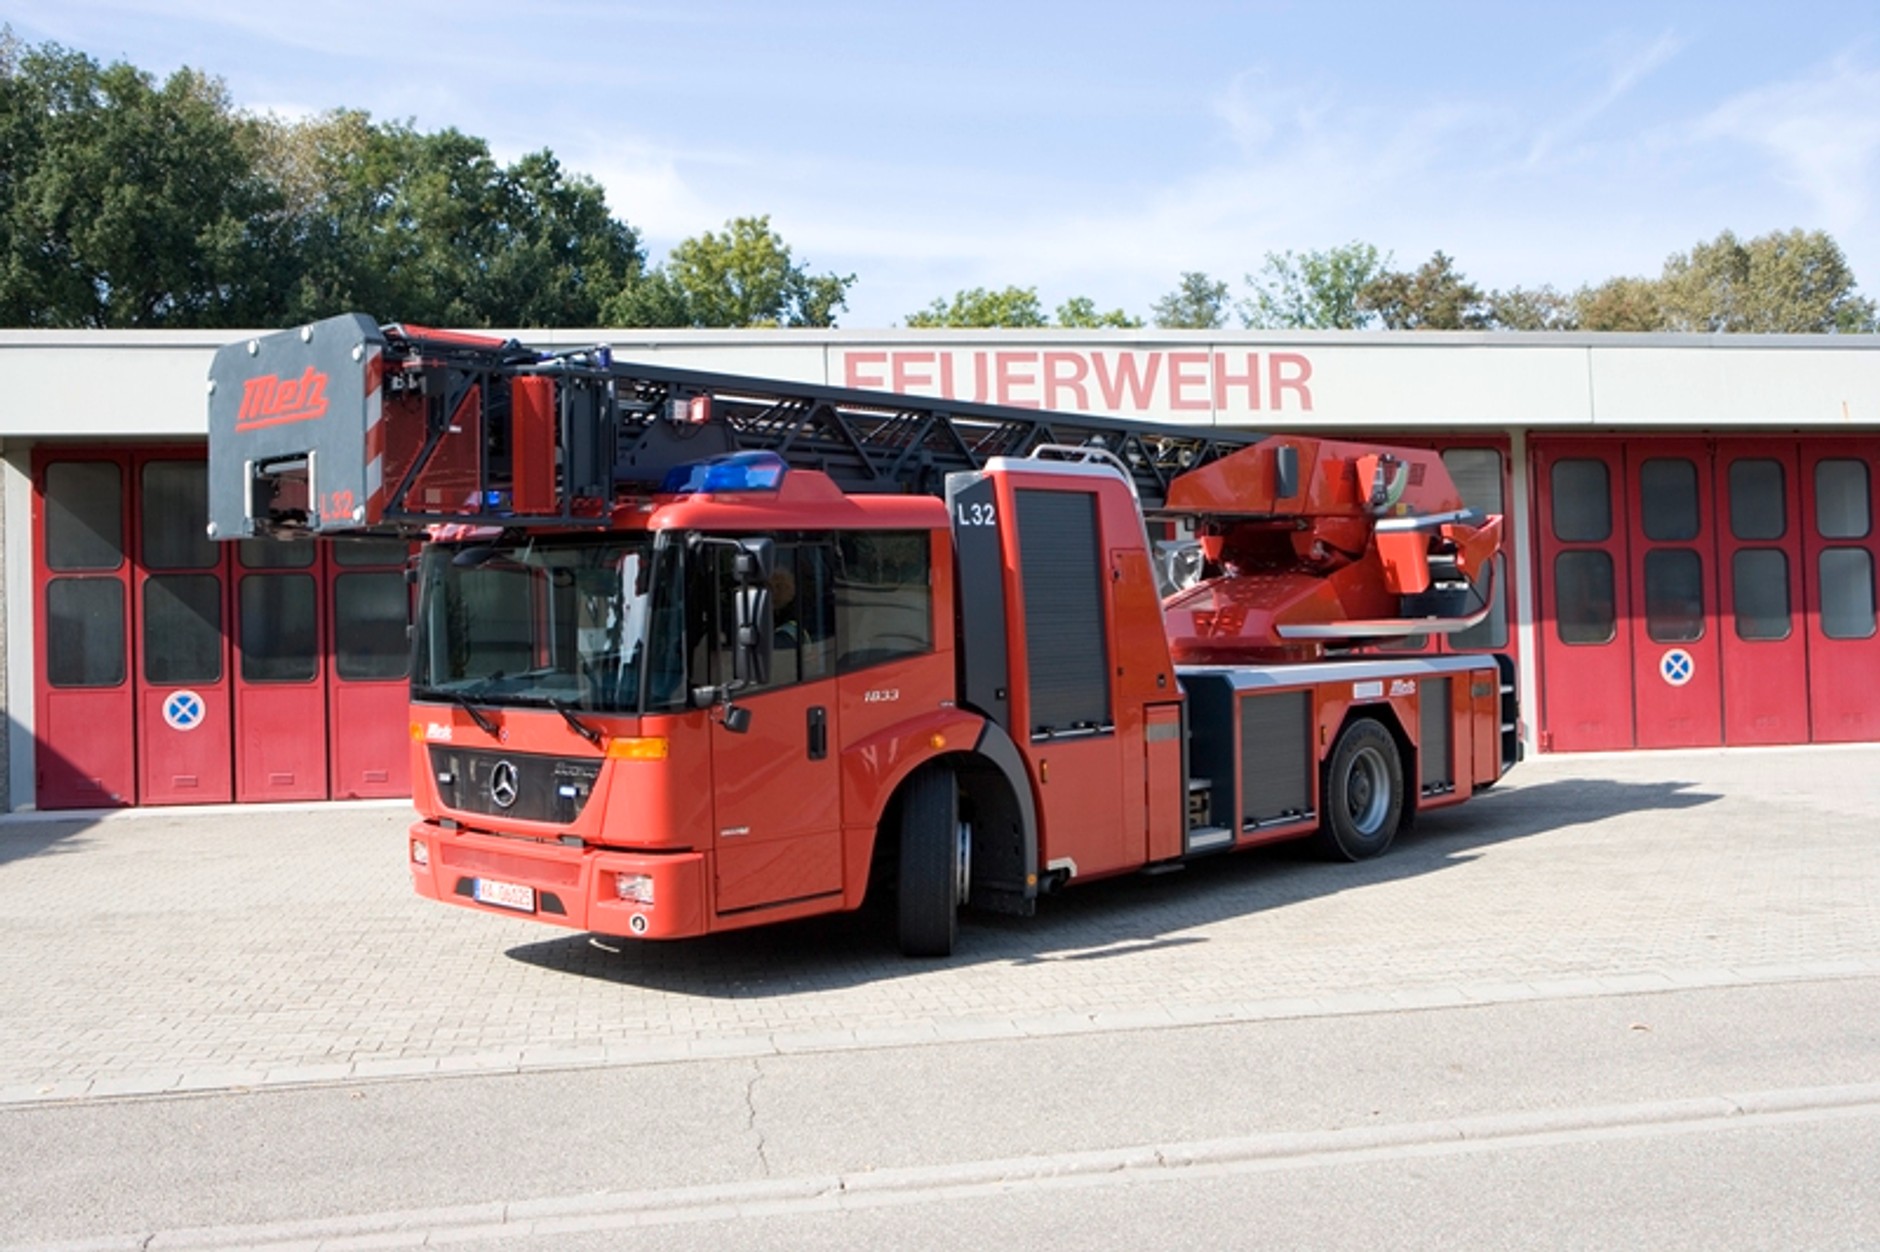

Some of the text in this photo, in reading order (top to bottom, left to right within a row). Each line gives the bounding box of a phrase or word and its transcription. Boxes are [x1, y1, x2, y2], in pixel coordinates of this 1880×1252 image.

[236, 366, 328, 432] Metz
[843, 352, 1314, 411] FEUERWEHR
[320, 489, 354, 522] L32
[958, 503, 996, 526] L32
